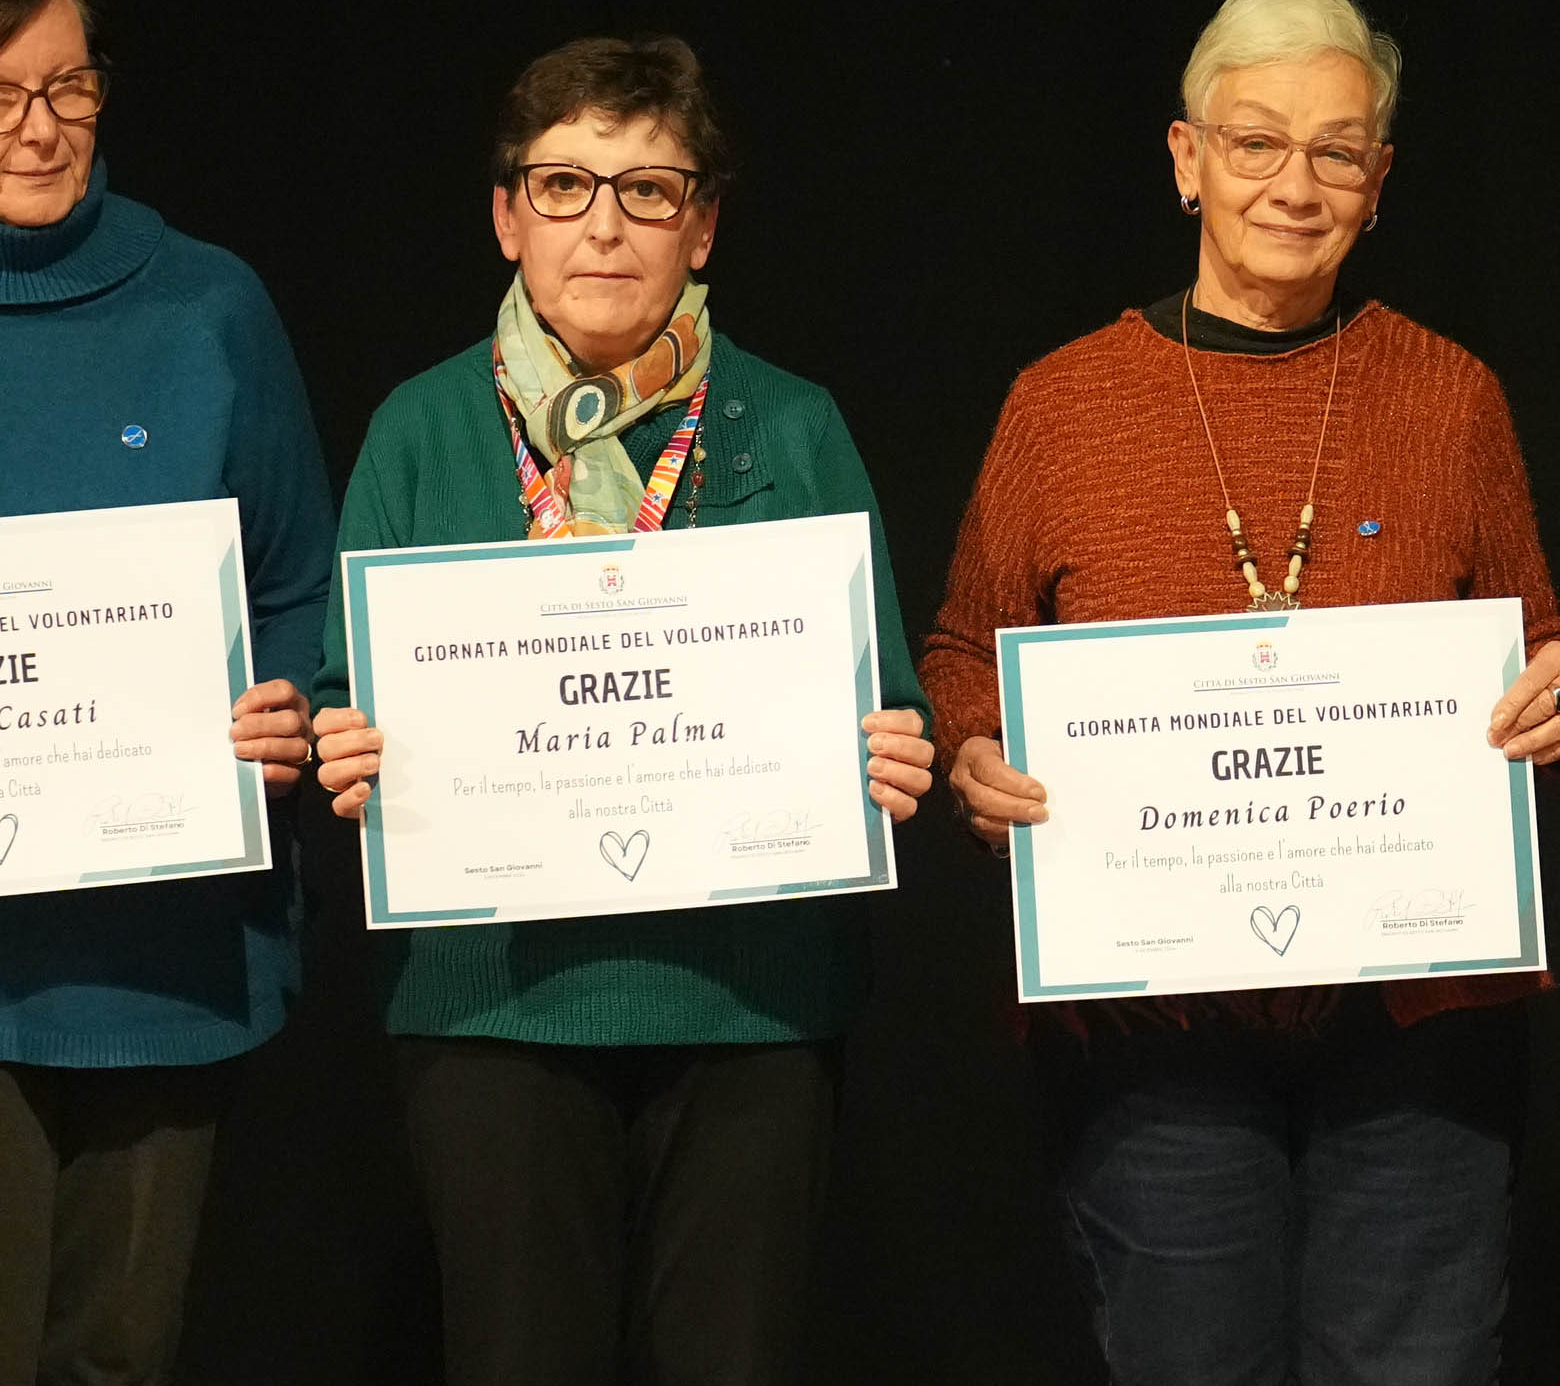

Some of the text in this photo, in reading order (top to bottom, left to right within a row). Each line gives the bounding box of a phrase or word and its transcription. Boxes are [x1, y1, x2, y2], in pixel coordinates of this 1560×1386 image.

[28, 602, 173, 630] VOLONTARIATO
[414, 617, 804, 663] GIORNATA MONDIALE DEL VOLONTARIATO
[559, 668, 673, 706] GRAZIE
[515, 711, 726, 755] Maria Palma
[1066, 698, 1458, 738] GIORNATA MONDIALE DEL VOLONTARIATO
[46, 742, 71, 765] che
[72, 741, 93, 762] hai
[96, 737, 153, 760] dedicato
[1211, 744, 1325, 782] GRAZIE
[7, 778, 42, 798] Città
[452, 754, 781, 798] Per il tempo, la passione e l'amore che hai dedicato
[568, 794, 674, 820] alla nostra Città
[1139, 792, 1406, 831] Domenica Poerio
[1105, 832, 1434, 872] Per il tempo, la passione e l'amore che hai dedicato
[1219, 869, 1324, 894] alla nostra Città
